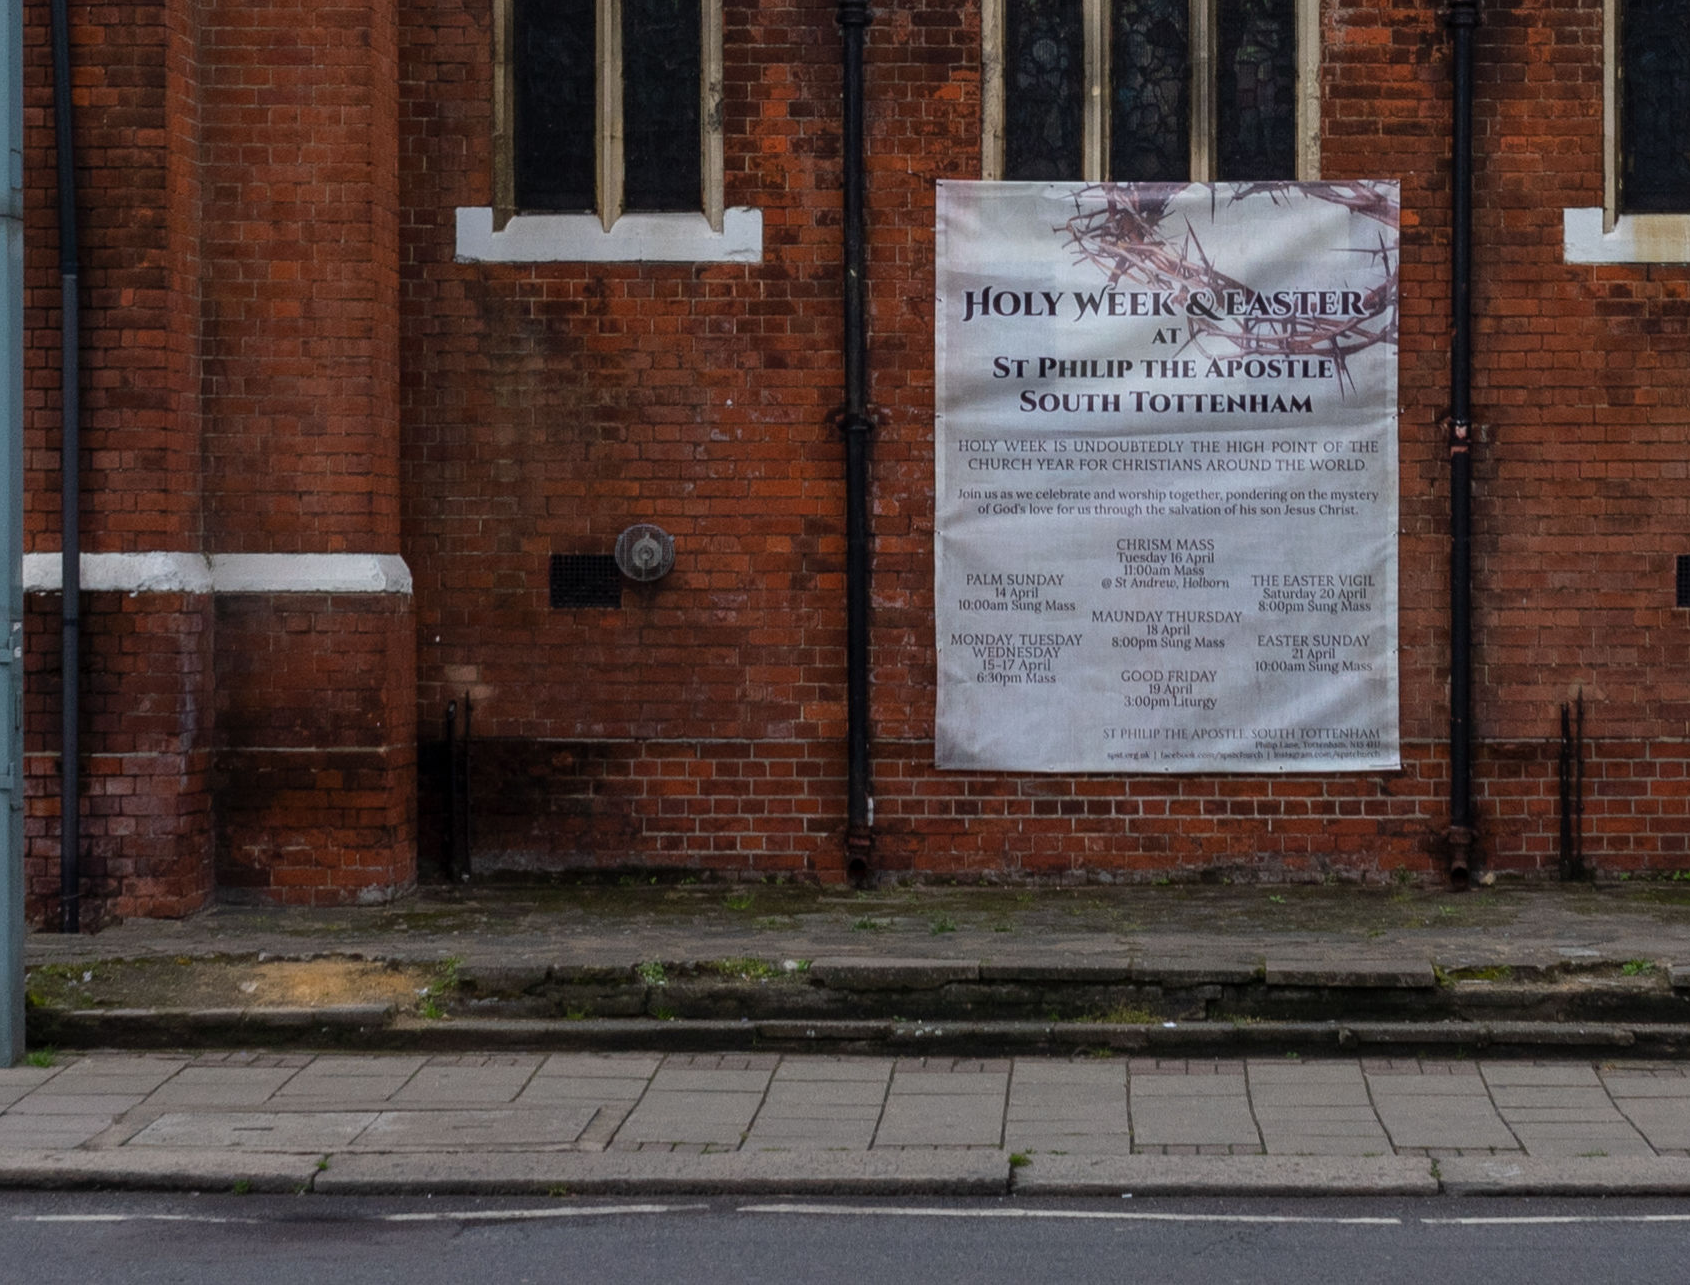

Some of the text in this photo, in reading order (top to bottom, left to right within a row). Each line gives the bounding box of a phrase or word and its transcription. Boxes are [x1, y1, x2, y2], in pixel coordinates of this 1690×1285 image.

[962, 284, 1366, 321] HOLY WEEK & EASTER
[1152, 328, 1181, 344] AT
[993, 356, 1333, 378] ST PHILIP THE APOSTLE
[1020, 390, 1313, 413] SOUTH TOTTENHAM
[958, 440, 1379, 453] HOLY WEEK IS UNDOUBTEDLY THE HIGH POINT OF THE
[968, 458, 1032, 471] CHURCH
[1037, 458, 1075, 471] YEAR
[1079, 458, 1108, 471] FOR
[1112, 458, 1202, 471] CHRISTIANS
[1206, 458, 1272, 471] AROUND
[1275, 458, 1305, 471] THE
[958, 489, 1379, 503] Join us as we celebrate and worship together, pondering on the mystery
[978, 503, 991, 515] of
[1029, 503, 1053, 515] love
[1057, 503, 1074, 515] for
[1078, 506, 1091, 515] us
[1094, 503, 1144, 518] through
[1146, 503, 1166, 515] the
[1168, 503, 1221, 515] salvation
[1225, 503, 1237, 515] of
[1239, 503, 1256, 515] his
[1260, 506, 1281, 515] son
[1284, 503, 1316, 515] Jesus
[1319, 503, 1359, 515] Christ.
[1117, 539, 1214, 551] CHRISM MASS
[1117, 552, 1214, 565] Tuesday 16 April
[1125, 565, 1204, 576] 11:00am Mass
[967, 574, 1063, 586] PALM SUNDAY
[1101, 577, 1230, 590] @ St Andrew, Holborn
[1252, 575, 1375, 587] THE EASTER VIGIL
[996, 587, 1038, 601] 14 April
[1263, 588, 1366, 602] Saturday 20 April
[959, 600, 1076, 614] 10:00am Sung Mass
[1258, 601, 1372, 614] 8:00pm Sung Mass
[1092, 611, 1241, 623] MAUNDAY THURSDAY
[1147, 624, 1190, 638] 18 April
[1019, 634, 1082, 646] TUESDAY
[1112, 637, 1225, 651] 8:00pm Sung Mass
[1258, 635, 1370, 647] EASTER SUNDAY
[972, 647, 1061, 658] WEDNESDAY
[1292, 648, 1335, 662] 21 April
[1019, 659, 1050, 674] April
[1255, 661, 1372, 674] 10:00am Sung Mass
[977, 672, 1056, 686] 6:30pm Mass
[1121, 670, 1216, 681] GOOD FRIDAY
[1150, 684, 1192, 697] 19 April
[1125, 696, 1217, 710] 3:00pm Liturgy
[1103, 728, 1115, 739] ST
[1121, 728, 1160, 739] PHILIP
[1164, 728, 1188, 739] THE
[1251, 728, 1294, 739] SOUTH
[1300, 728, 1380, 739] TOTTENHAM
